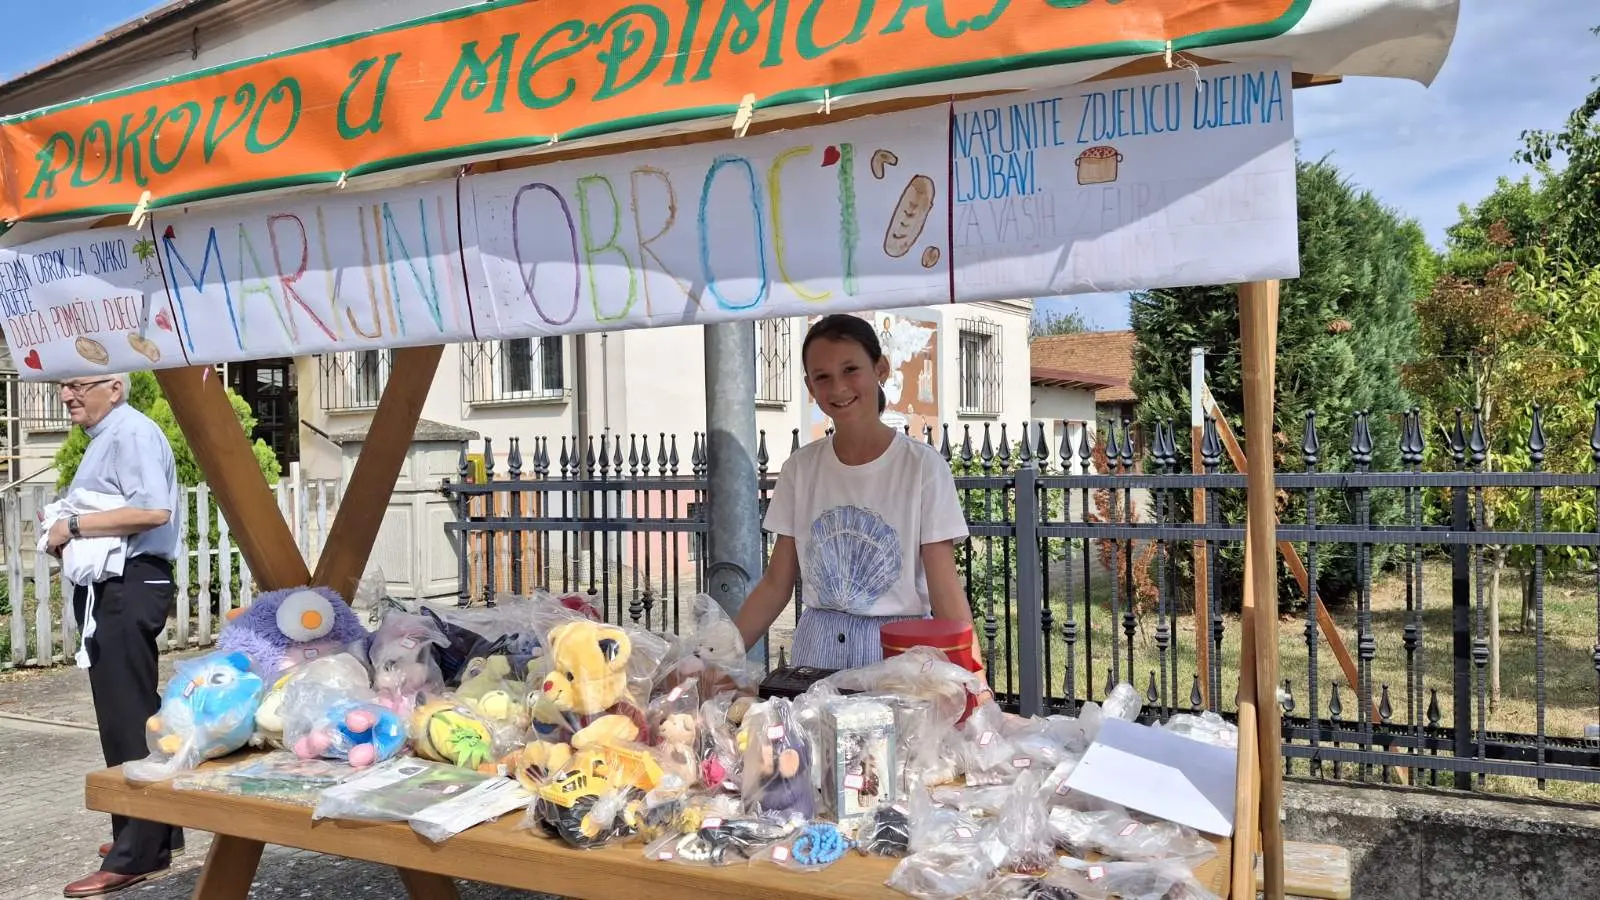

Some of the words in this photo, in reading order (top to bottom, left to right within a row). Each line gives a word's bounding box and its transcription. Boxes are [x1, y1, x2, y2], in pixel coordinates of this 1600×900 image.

[336, 52, 402, 139] U
[424, 0, 1126, 121] MEĐIMU
[953, 97, 1064, 159] NAPUNITE
[1076, 82, 1181, 145] ZDJELICU
[1193, 70, 1285, 130] DJELIMA
[953, 151, 1042, 203] LJUBAVI.
[32, 248, 71, 285] OBROK
[73, 246, 87, 277] ZA
[90, 239, 128, 275] SVAKO
[163, 196, 461, 353] MARIJINI
[512, 143, 860, 326] OBROCI
[8, 311, 51, 348] DJECA
